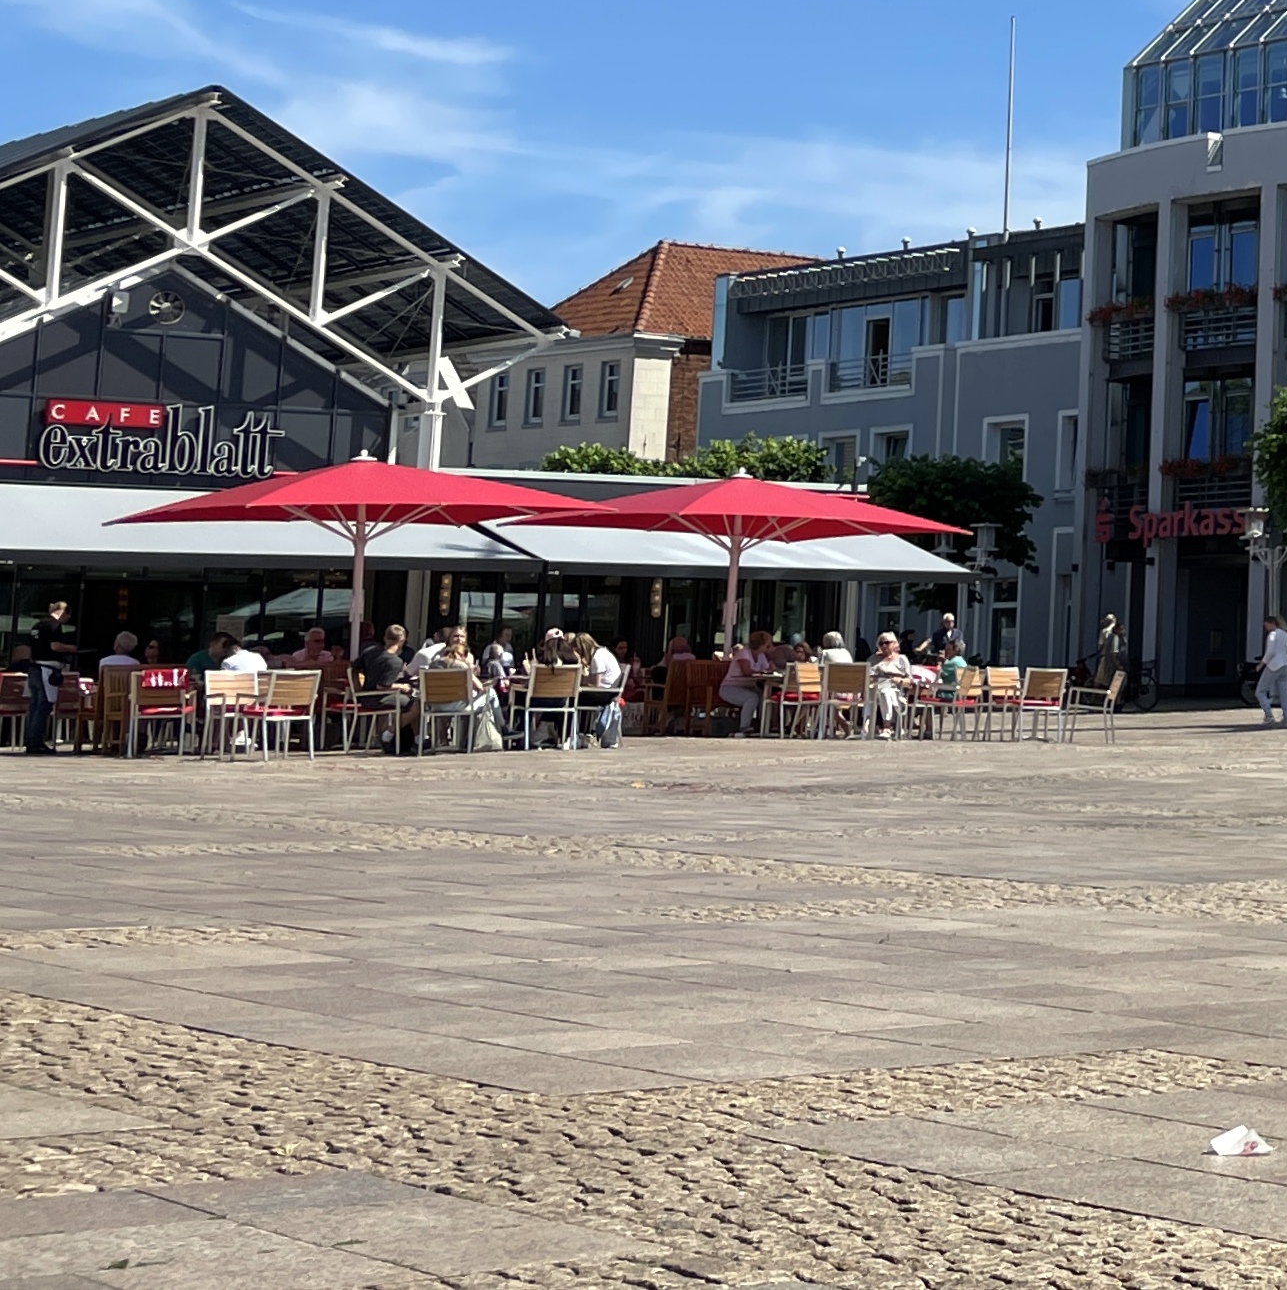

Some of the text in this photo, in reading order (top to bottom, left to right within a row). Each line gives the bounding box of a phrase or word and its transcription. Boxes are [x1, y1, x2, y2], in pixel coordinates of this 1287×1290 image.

[50, 403, 162, 425] CAFE
[38, 403, 286, 479] extrablatt
[1128, 500, 1247, 548] Sparkass
